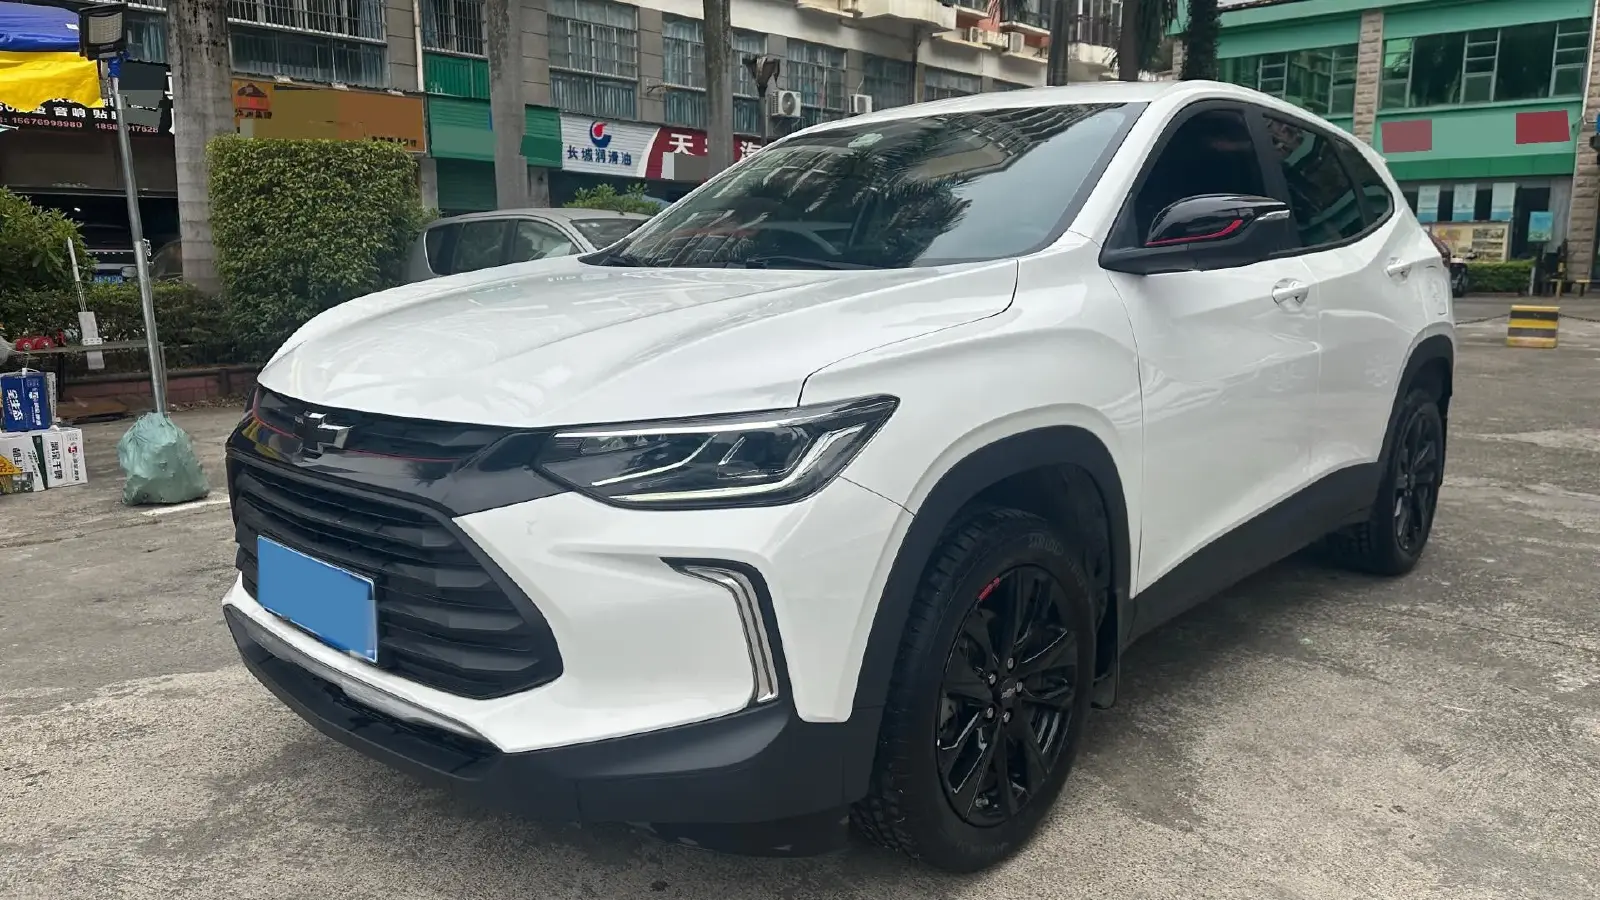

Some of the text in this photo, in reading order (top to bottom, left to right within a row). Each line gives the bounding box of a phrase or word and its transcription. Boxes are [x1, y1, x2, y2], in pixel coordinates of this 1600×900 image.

[12, 117, 83, 128] 15676998980
[567, 145, 632, 166] 长城润滑油
